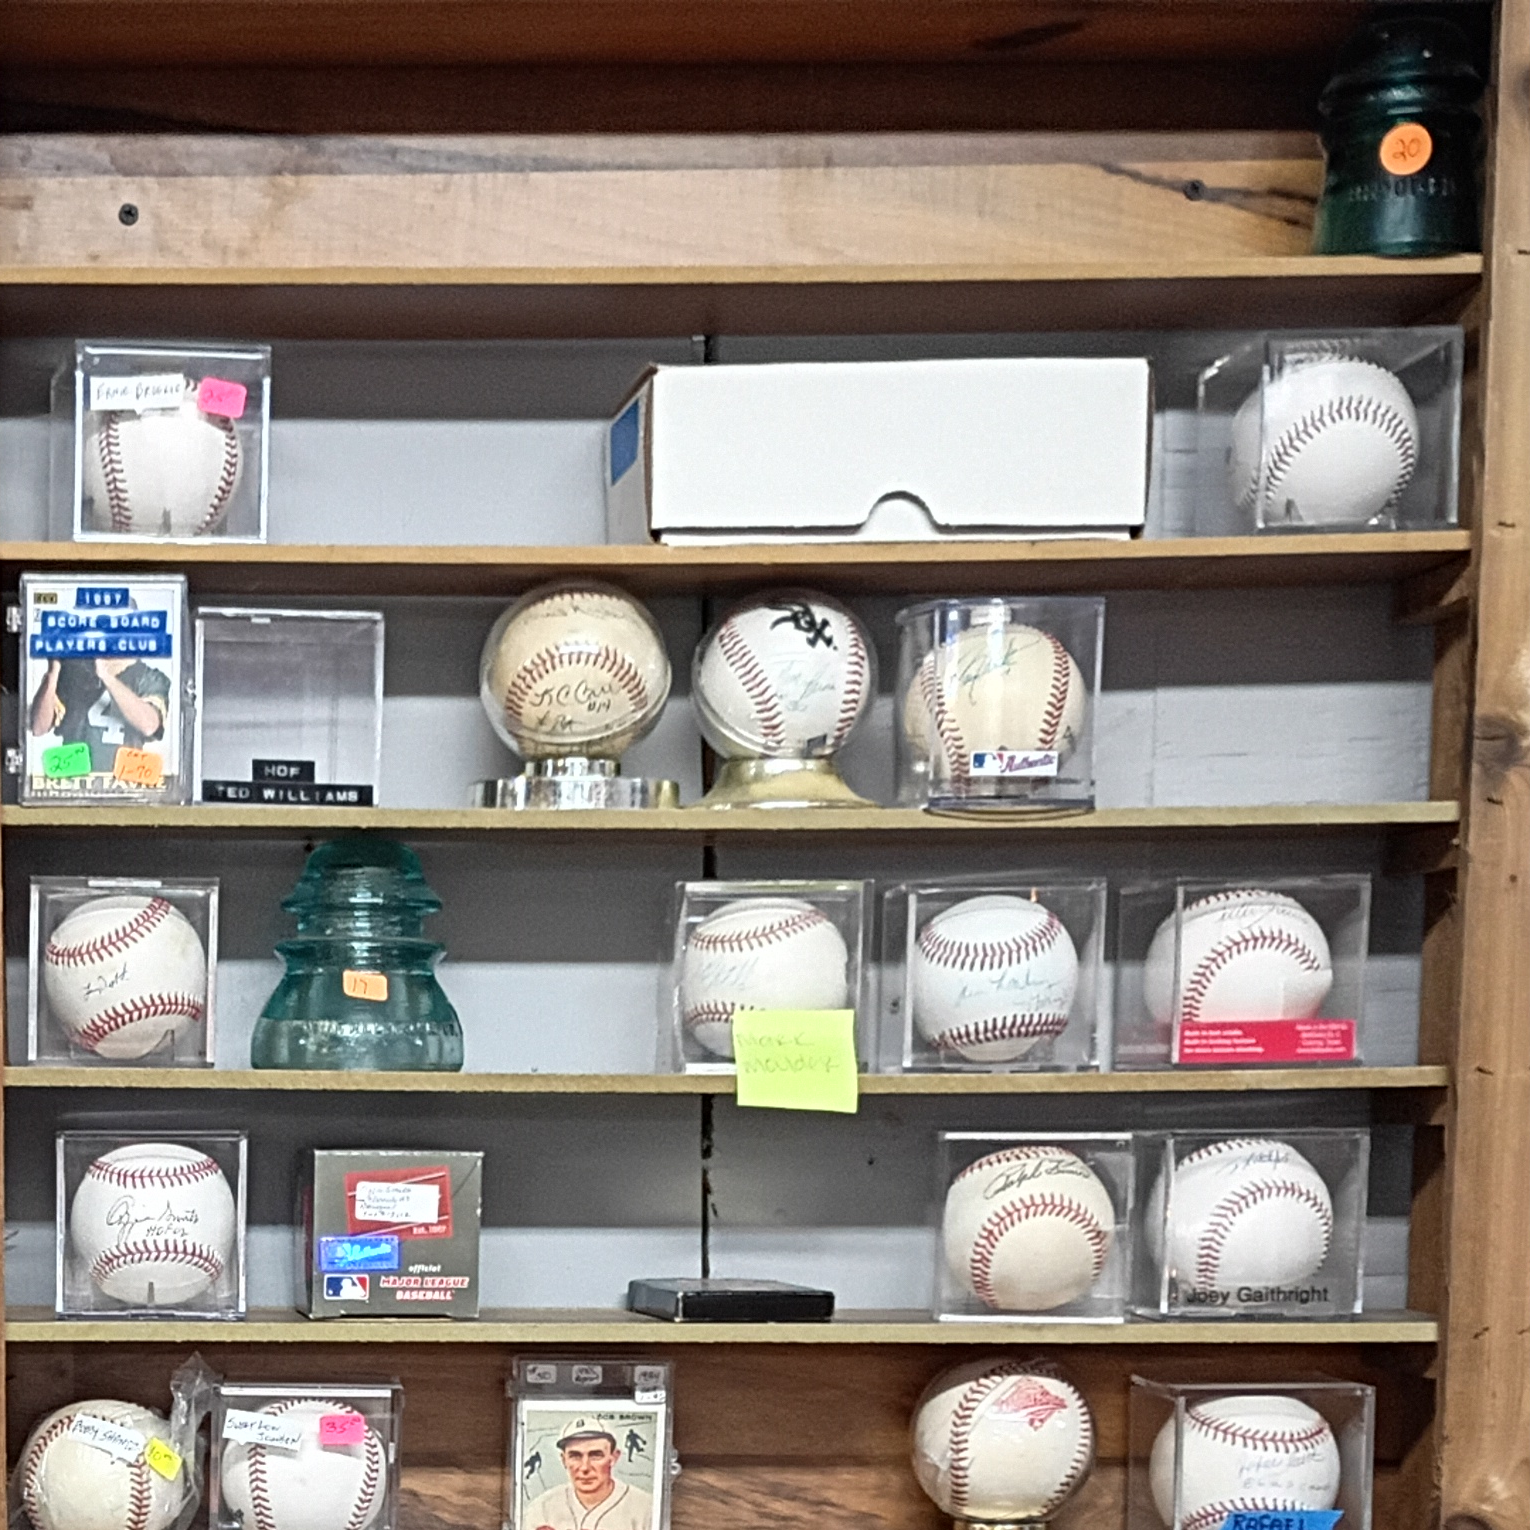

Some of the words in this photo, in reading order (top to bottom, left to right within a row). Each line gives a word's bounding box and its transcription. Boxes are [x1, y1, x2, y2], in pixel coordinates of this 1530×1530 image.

[47, 615, 97, 628] SCORE
[110, 615, 161, 628] BOARD
[34, 637, 107, 651] PLAYERS
[118, 638, 157, 651] CLUB
[264, 765, 301, 778] HOF
[380, 1275, 420, 1288] MAJOR
[422, 1276, 469, 1289] LEAGUE
[396, 1288, 453, 1300] BASEBALL
[1187, 1287, 1232, 1304] Joey
